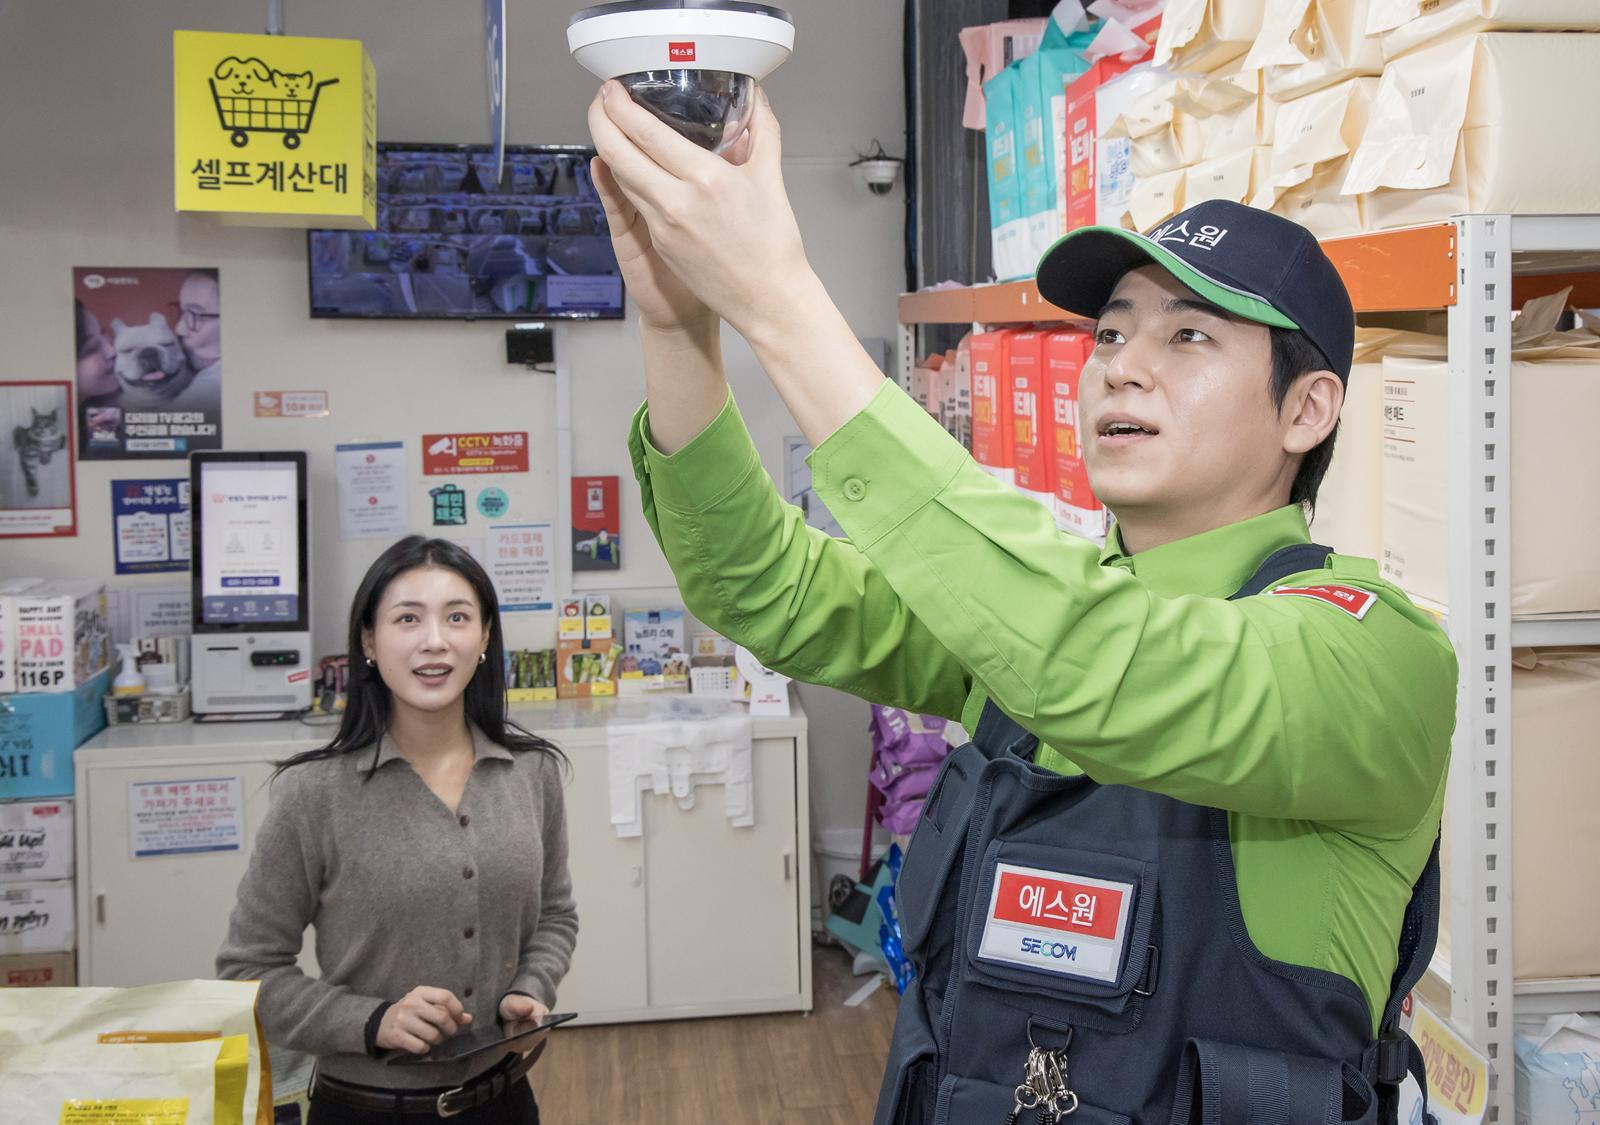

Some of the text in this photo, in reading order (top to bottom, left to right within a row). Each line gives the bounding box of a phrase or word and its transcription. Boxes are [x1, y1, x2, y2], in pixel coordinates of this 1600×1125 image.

[671, 48, 694, 56] 에스원
[192, 158, 348, 194] 셀프계산대
[457, 435, 490, 448] CCTV
[19, 624, 63, 636] SMALL
[20, 638, 64, 657] PAD
[1018, 884, 1097, 927] 에스원
[1020, 937, 1078, 961] SECOM
